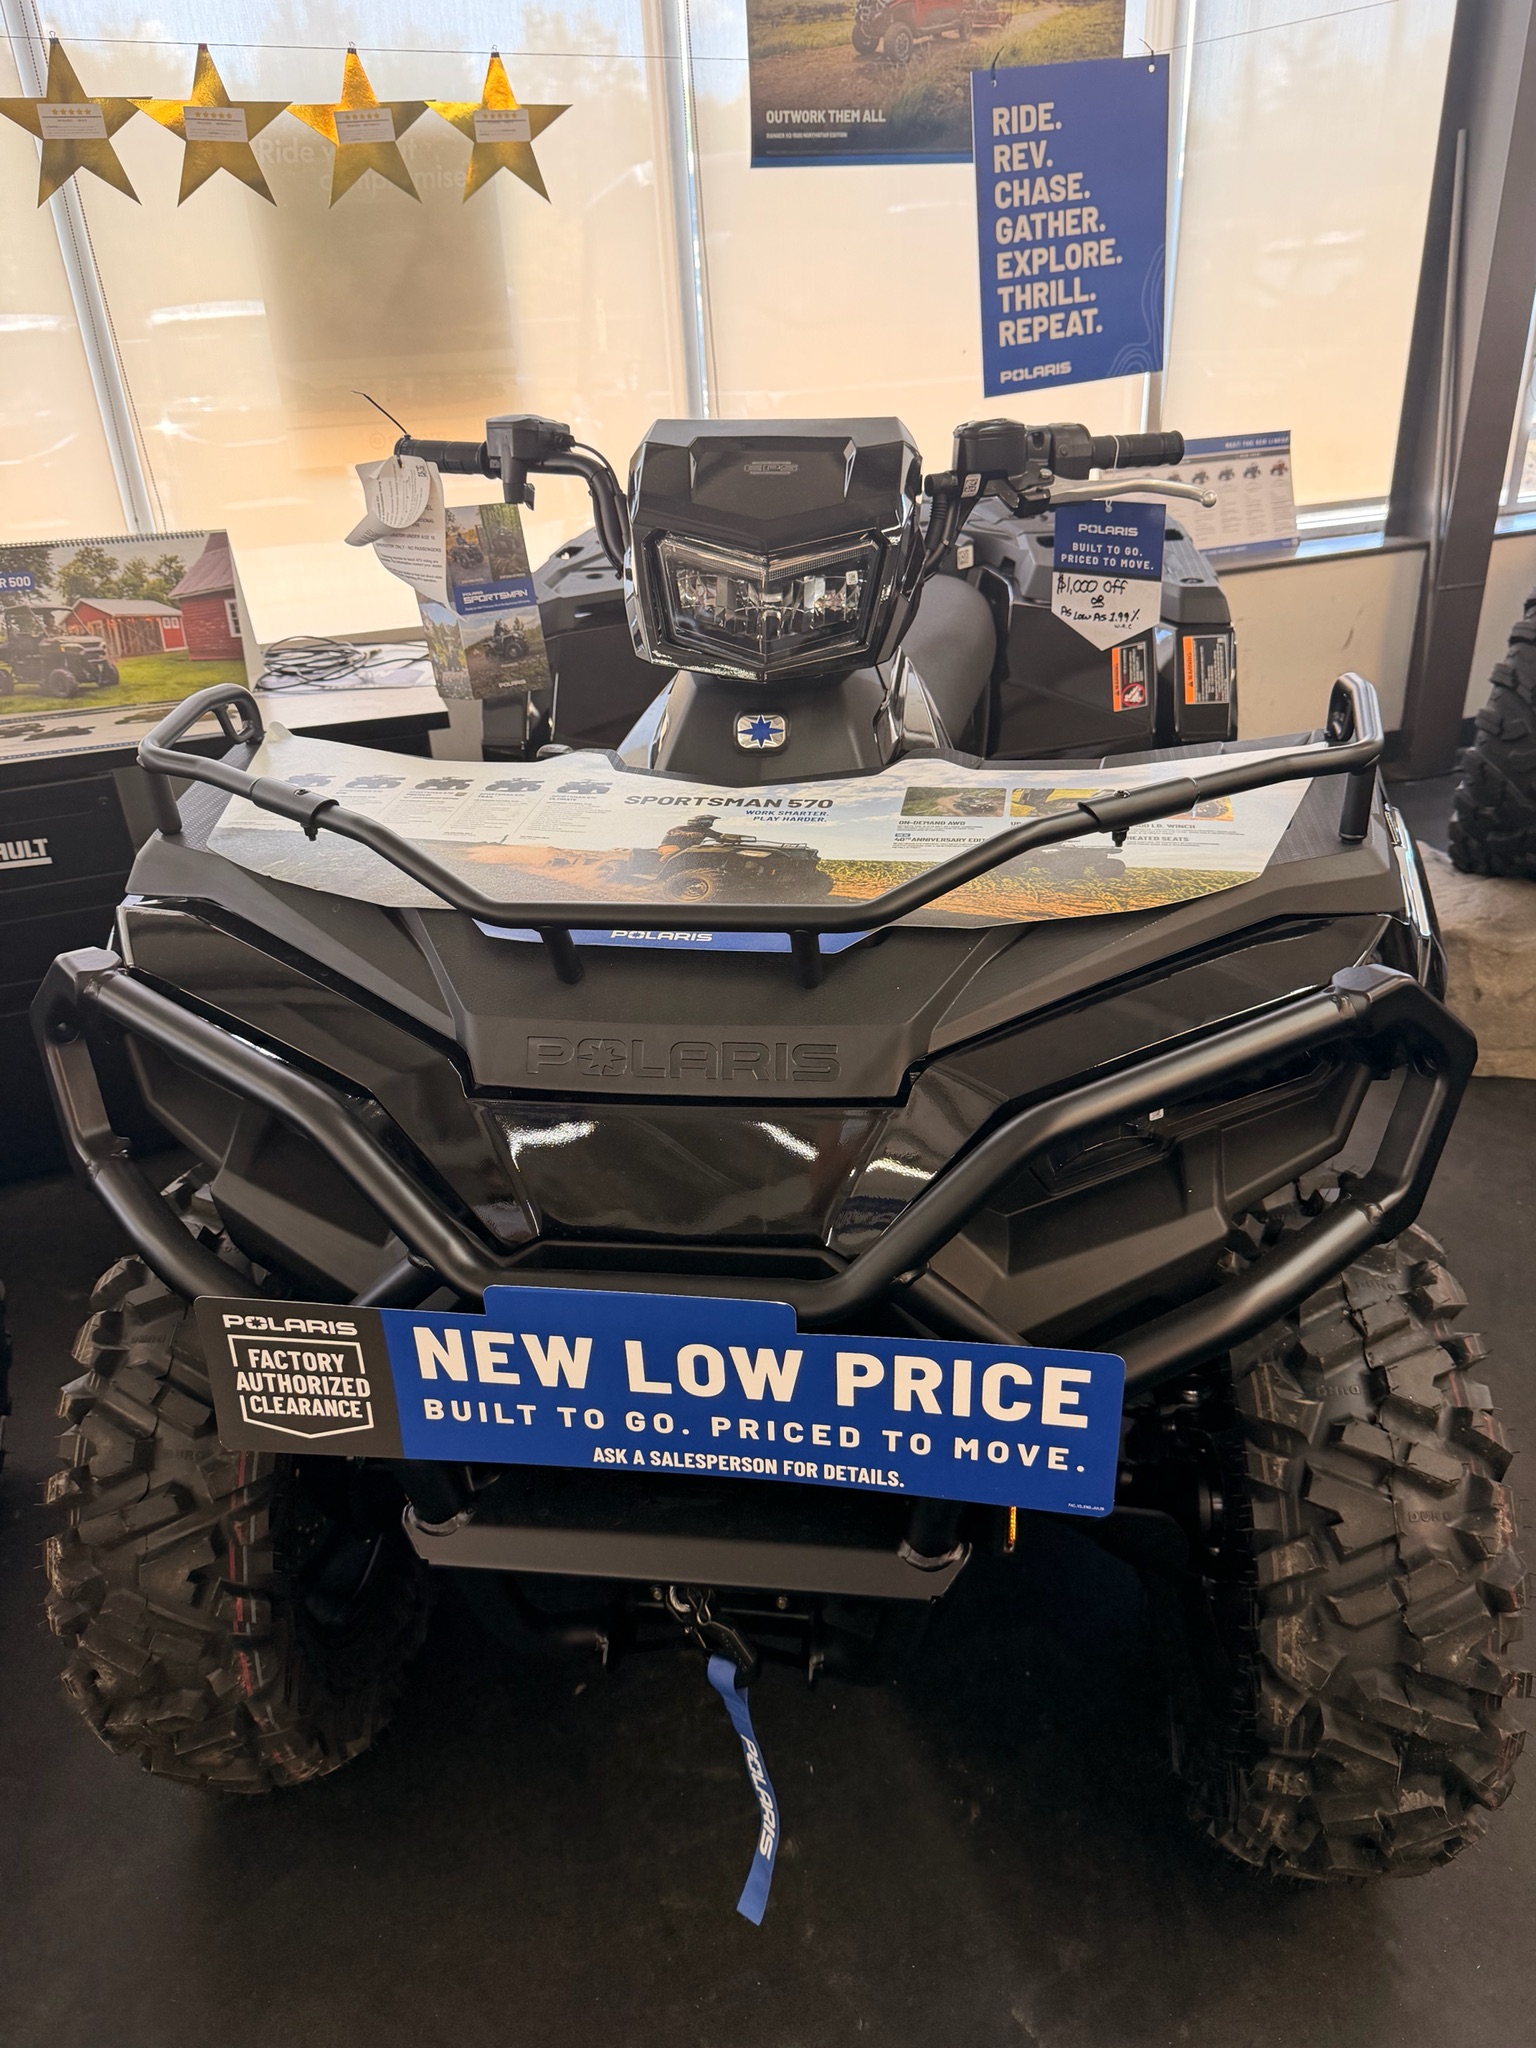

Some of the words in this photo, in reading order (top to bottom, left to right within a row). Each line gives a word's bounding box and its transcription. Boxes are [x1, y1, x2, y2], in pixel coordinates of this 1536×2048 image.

[766, 110, 826, 124] OUTWORK
[828, 109, 861, 123] THEM
[863, 108, 886, 123] ALL
[992, 102, 1062, 136] RIDE.
[993, 140, 1053, 173] REV.
[994, 172, 1091, 209] CHASE.
[995, 206, 1106, 245] GATHER.
[996, 238, 1123, 280] EXPLORE.
[997, 276, 1097, 314] THRILL.
[998, 308, 1103, 347] REPEAT.
[1000, 361, 1072, 384] POLARIS
[1078, 523, 1139, 537] POLARIS
[1061, 553, 1099, 565] PRICED
[1103, 557, 1117, 566] TO
[1120, 559, 1154, 570] MOVE.
[1072, 542, 1103, 553] BUILT
[1107, 545, 1121, 554] TO
[1124, 547, 1143, 557] GO.
[8, 575, 31, 588] 500
[463, 588, 528, 605] SPORTSMAN
[624, 795, 787, 809] SPORTSMAN
[787, 799, 834, 809] 570
[610, 929, 713, 942] POLARIS
[526, 1035, 842, 1082] POLARIS
[222, 1313, 358, 1336] POLARIS
[247, 1348, 345, 1373] FACTORY
[236, 1371, 371, 1398] AUTHORIZED
[412, 1326, 593, 1389] NEW
[624, 1340, 803, 1402] LOW
[835, 1351, 1092, 1429] PRICE
[249, 1394, 363, 1419] CLEARANCE
[423, 1398, 536, 1425] BUILT
[556, 1406, 605, 1429] TO
[625, 1411, 690, 1435] GO.
[711, 1416, 861, 1448] PRICED
[882, 1429, 932, 1455] TO
[954, 1438, 1086, 1473] MOVE.
[592, 1446, 628, 1464] ASK
[632, 1449, 646, 1465] A
[649, 1449, 777, 1475] SALESPERSON
[783, 1460, 818, 1479] FOR
[823, 1462, 905, 1488] DETAILS.
[740, 1733, 777, 1861] POLARIS
